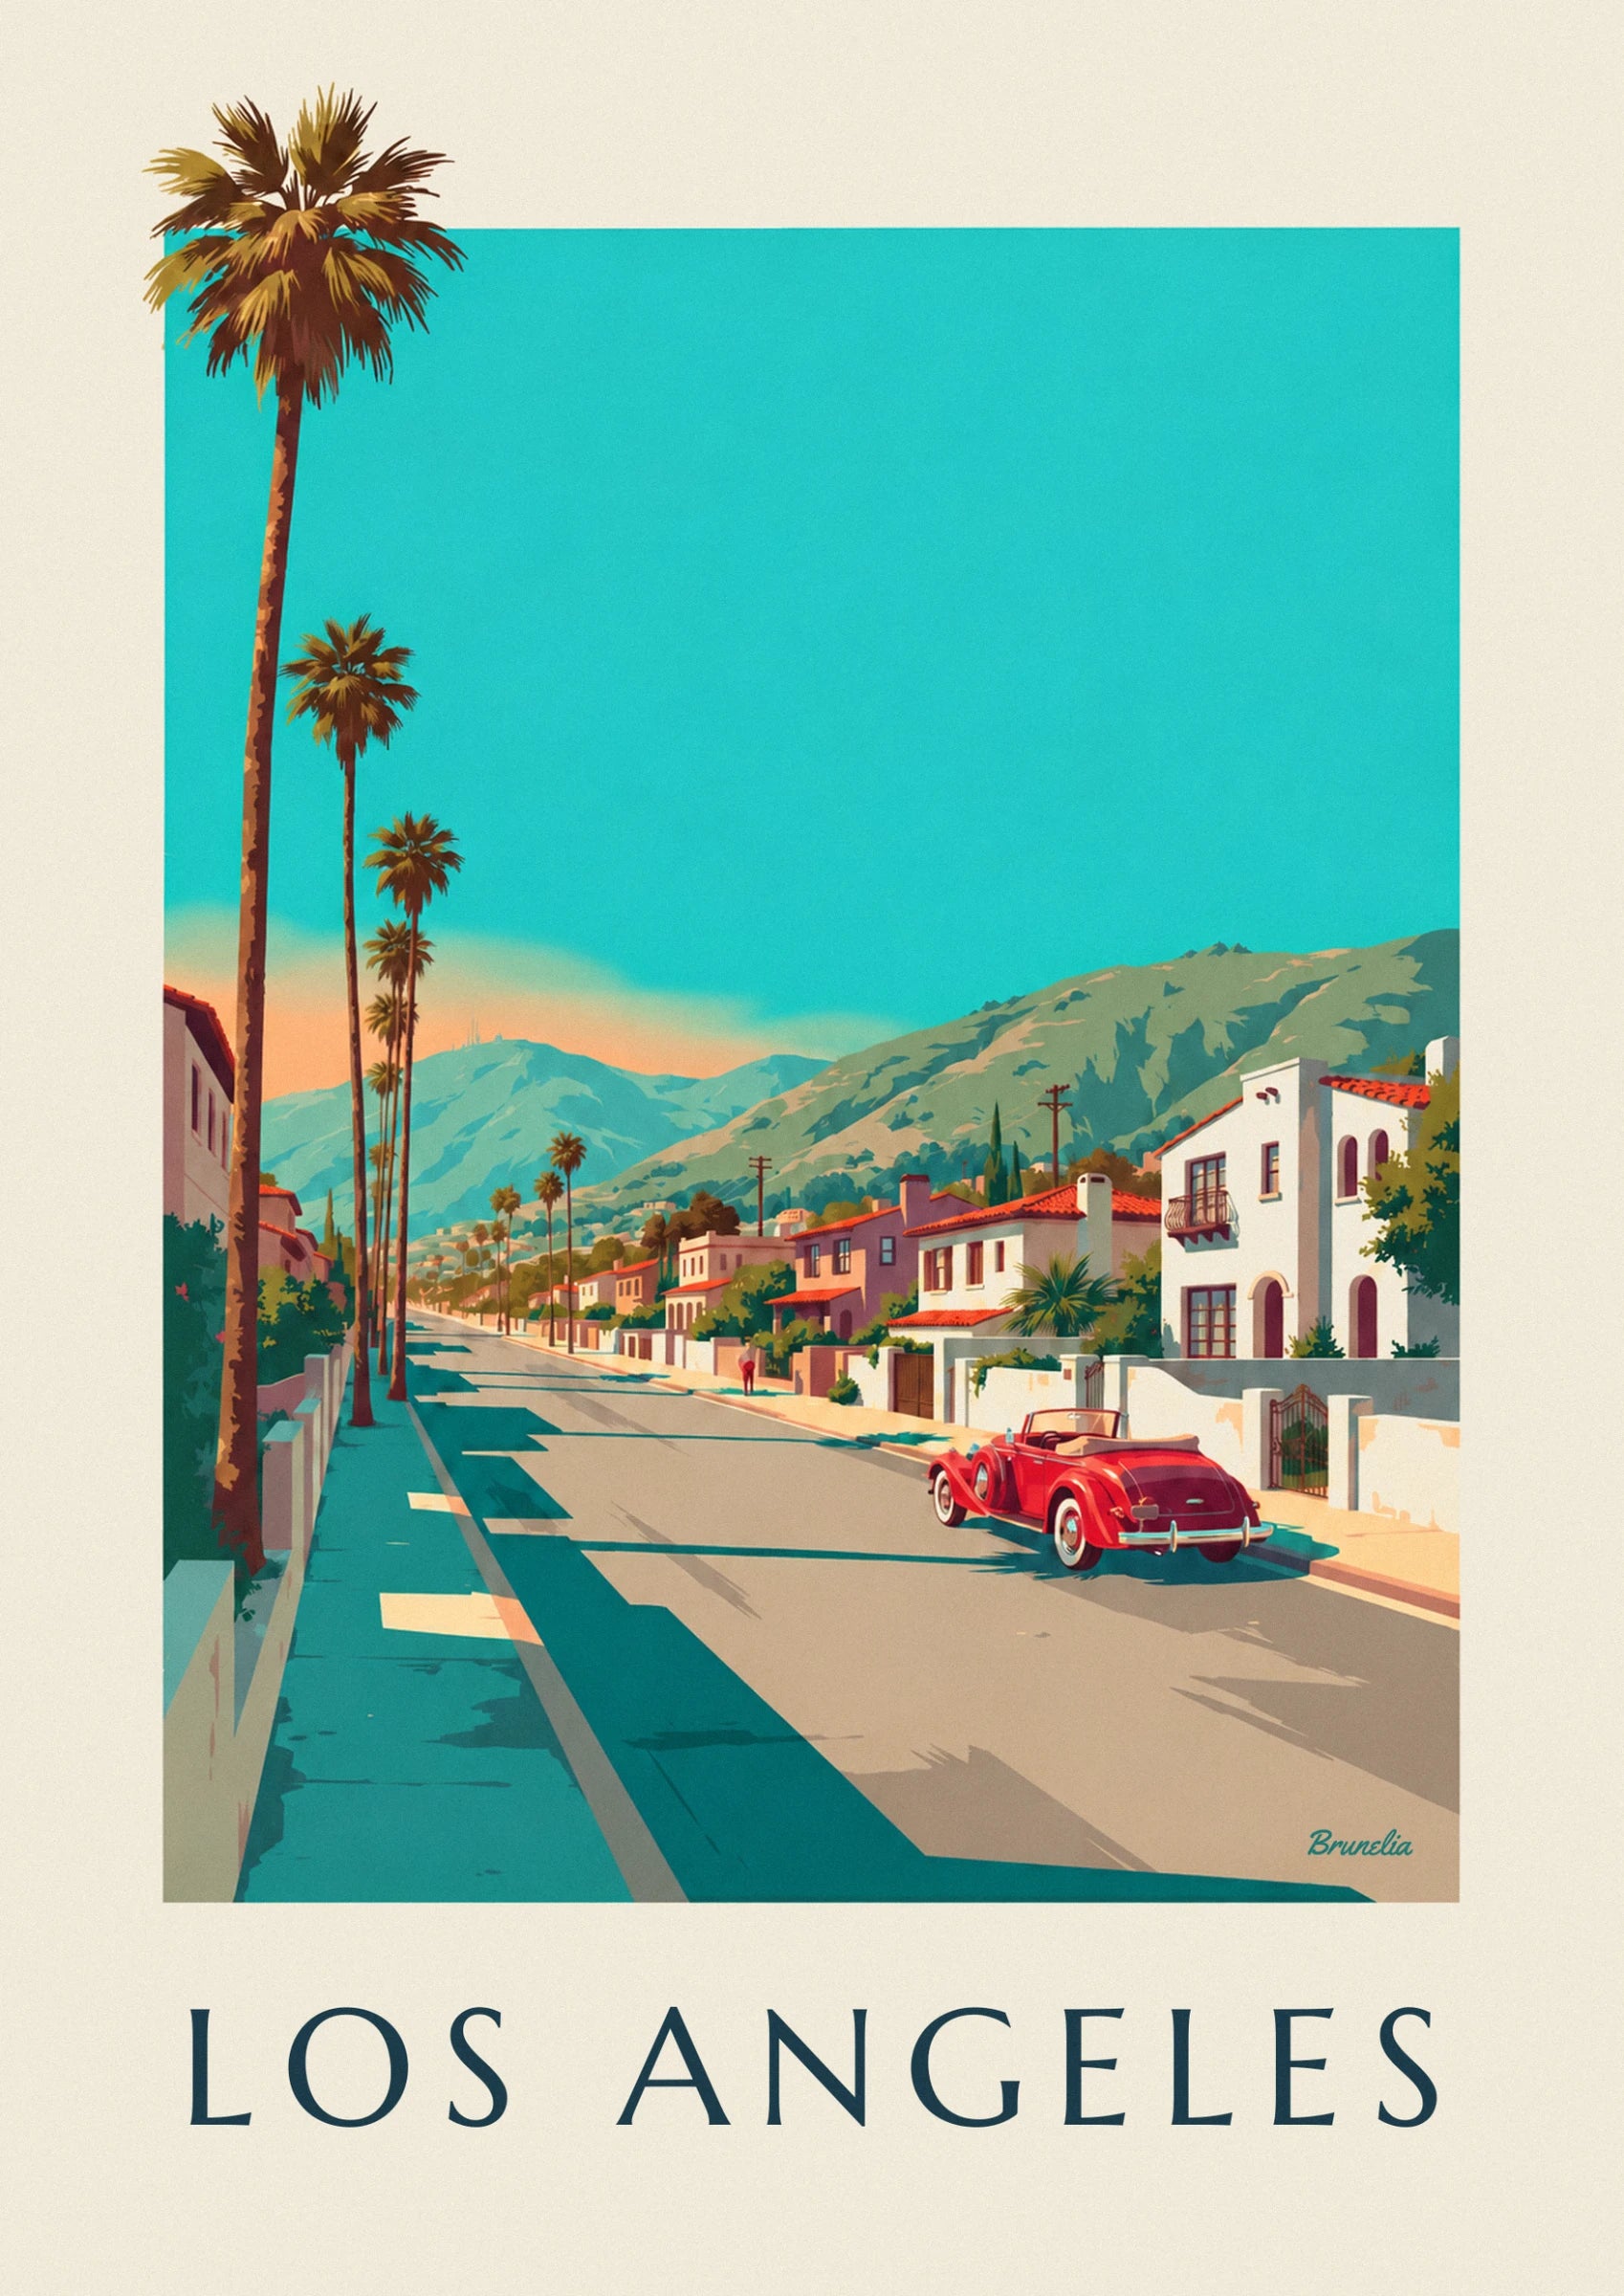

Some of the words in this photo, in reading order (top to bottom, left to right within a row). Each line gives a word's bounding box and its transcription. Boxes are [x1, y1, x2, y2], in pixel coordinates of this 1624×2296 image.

[1307, 1828, 1414, 1856] Brunelia
[189, 2006, 508, 2129] LOS
[616, 2006, 1439, 2129] ANGELES
